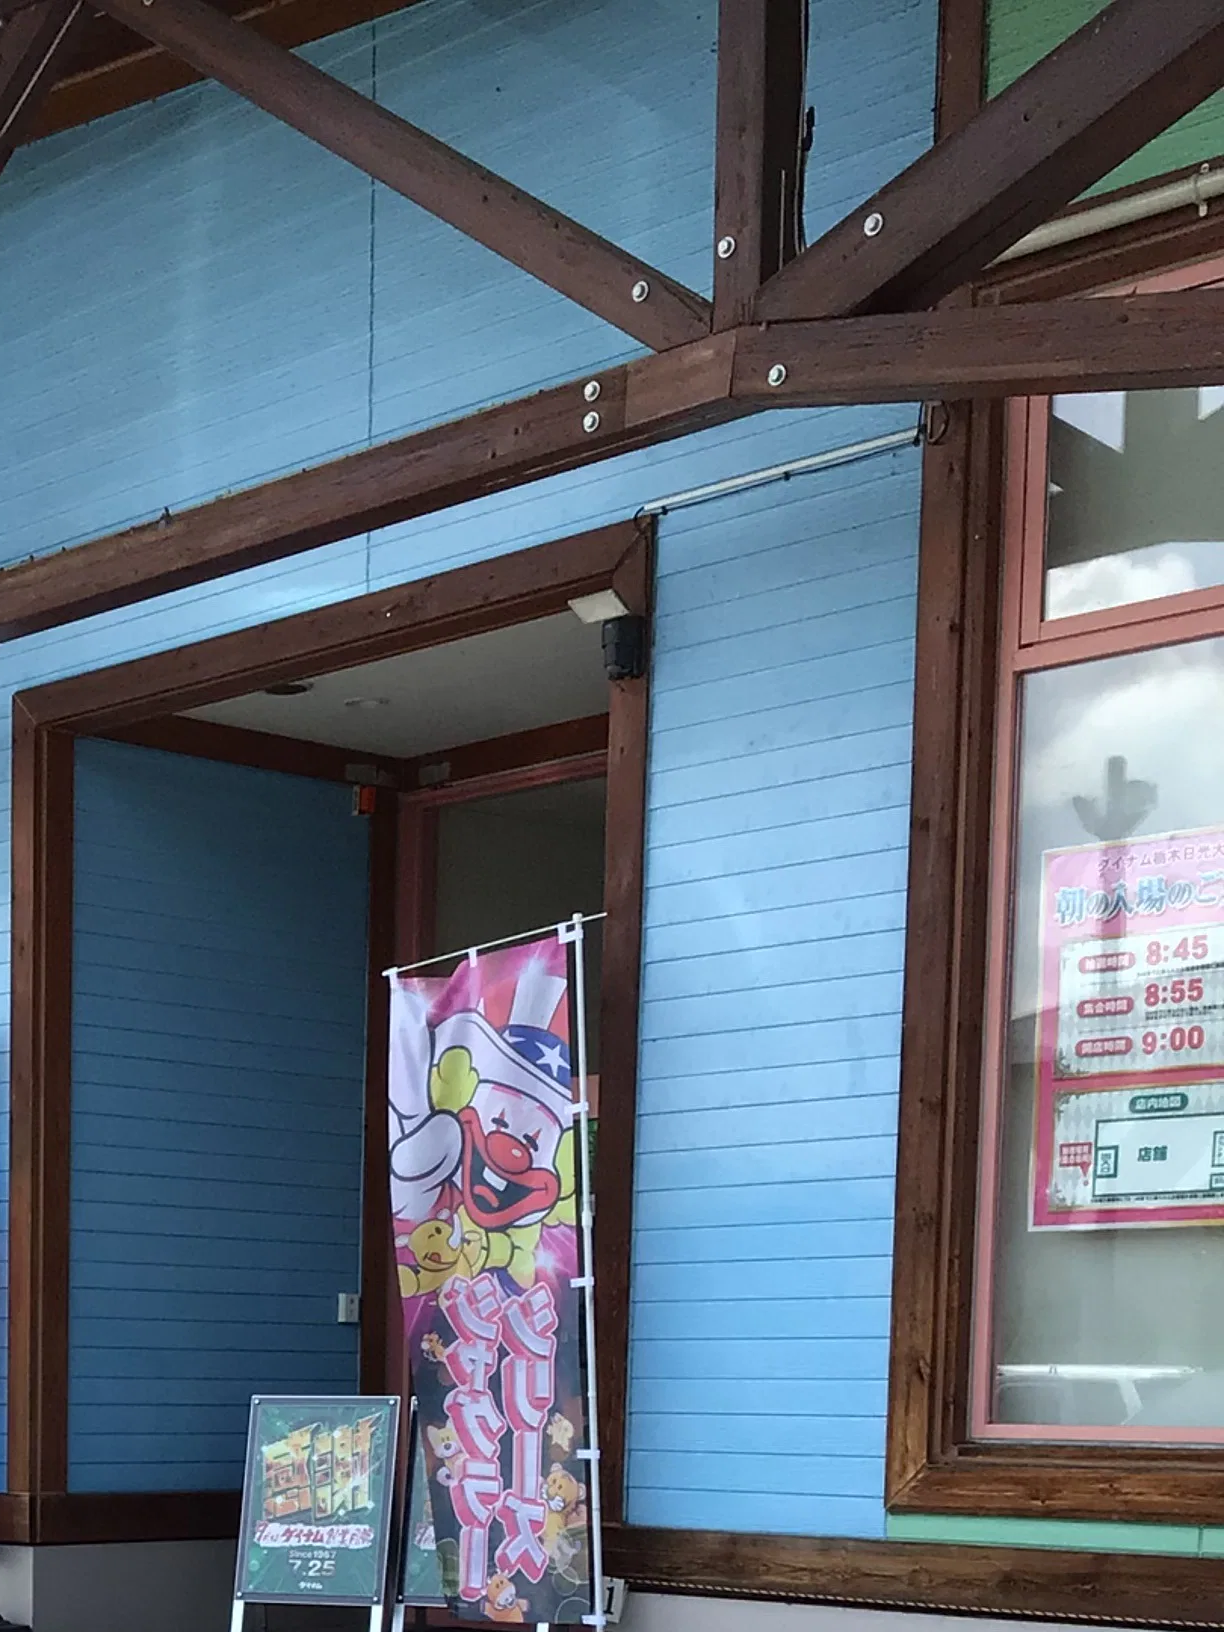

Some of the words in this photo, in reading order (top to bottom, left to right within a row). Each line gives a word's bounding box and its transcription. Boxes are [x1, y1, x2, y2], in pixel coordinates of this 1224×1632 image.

[1056, 869, 1224, 925] 朝の入場のご
[1146, 934, 1209, 966] 8:45
[1144, 977, 1204, 1007] 8:55
[1142, 1025, 1205, 1055] 9:00
[262, 1412, 382, 1519] 感謝
[288, 1560, 336, 1577] 7.25
